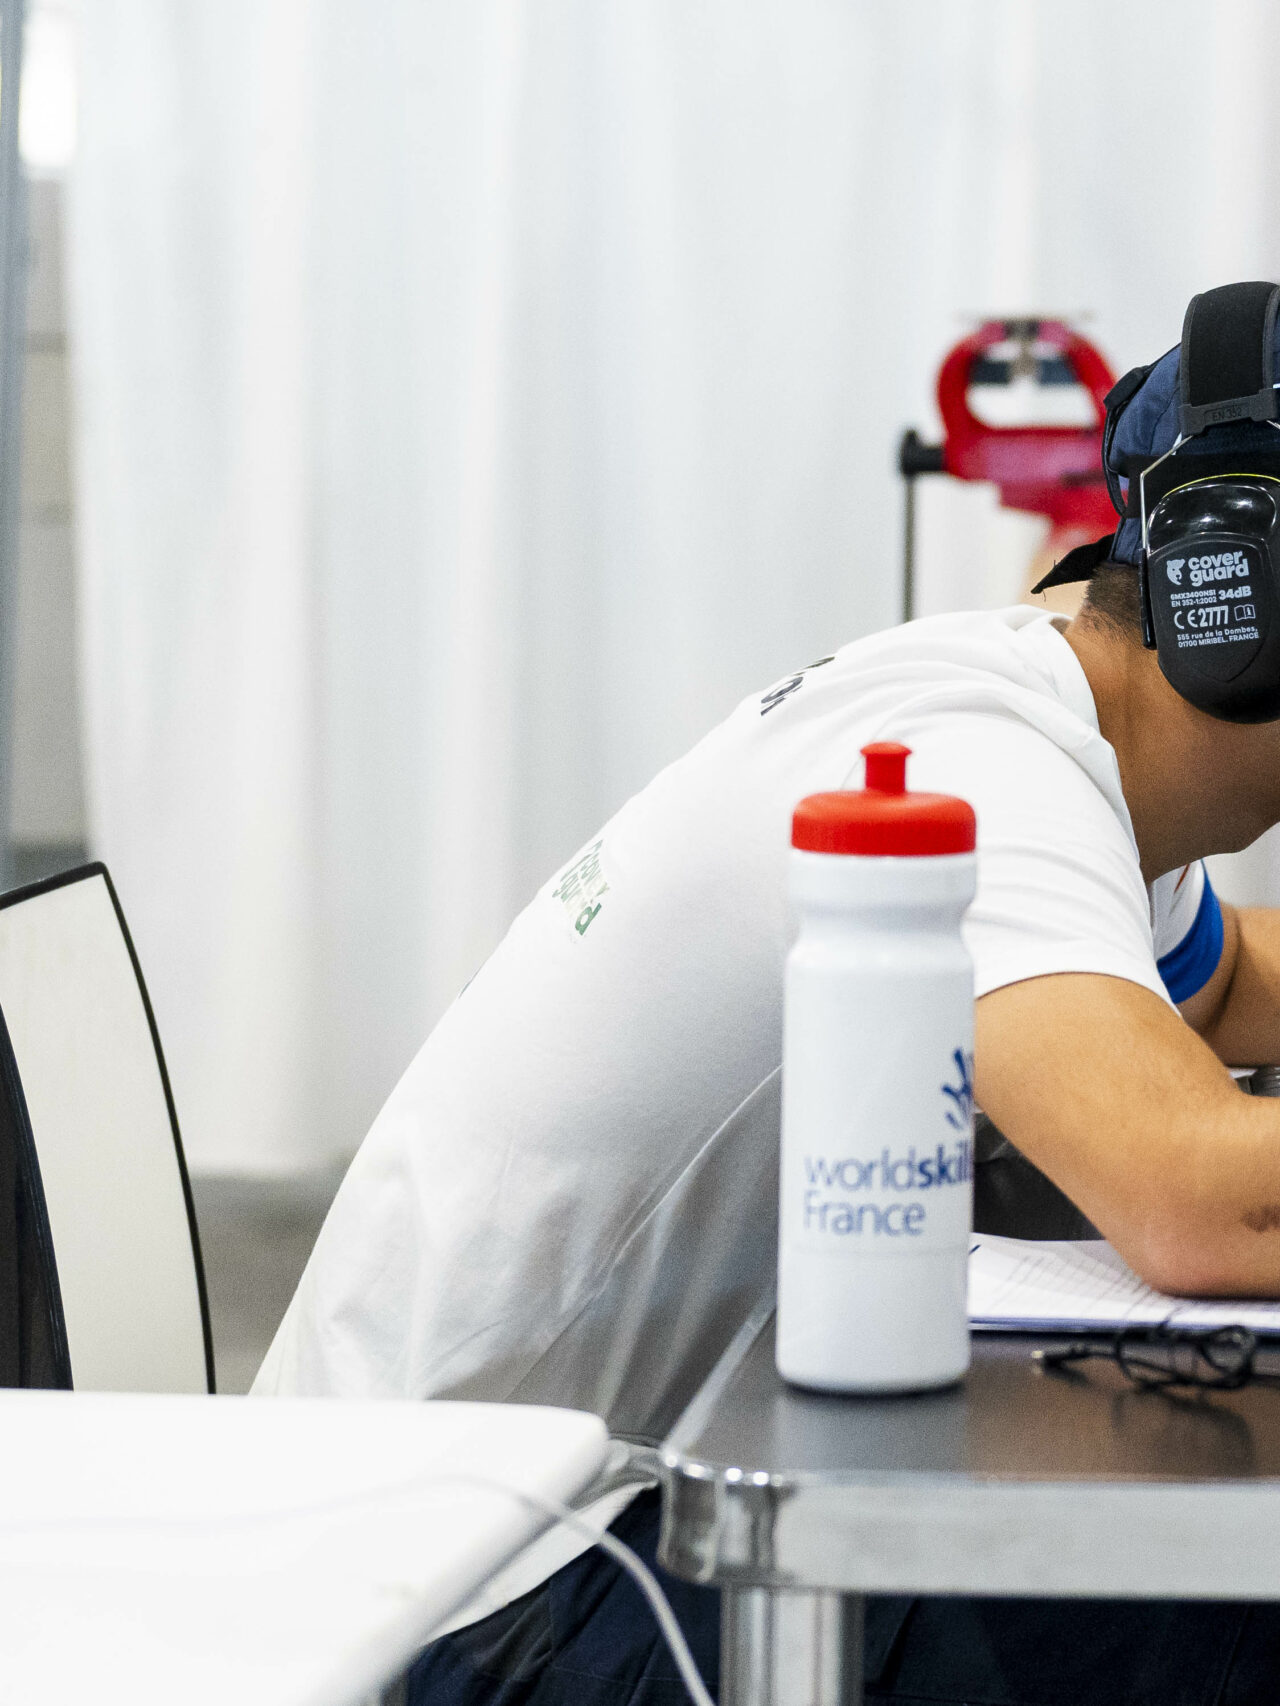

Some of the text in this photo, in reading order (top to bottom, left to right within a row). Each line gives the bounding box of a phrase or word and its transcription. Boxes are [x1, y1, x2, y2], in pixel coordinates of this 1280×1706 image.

[1188, 551, 1243, 570] cover
[1190, 559, 1249, 586] guard
[1219, 586, 1252, 600] 34dB
[1179, 640, 1197, 648] 01700
[1228, 631, 1260, 642] FRANCE
[1191, 632, 1203, 640] rue
[1204, 630, 1214, 638] de
[803, 1189, 926, 1236] France
